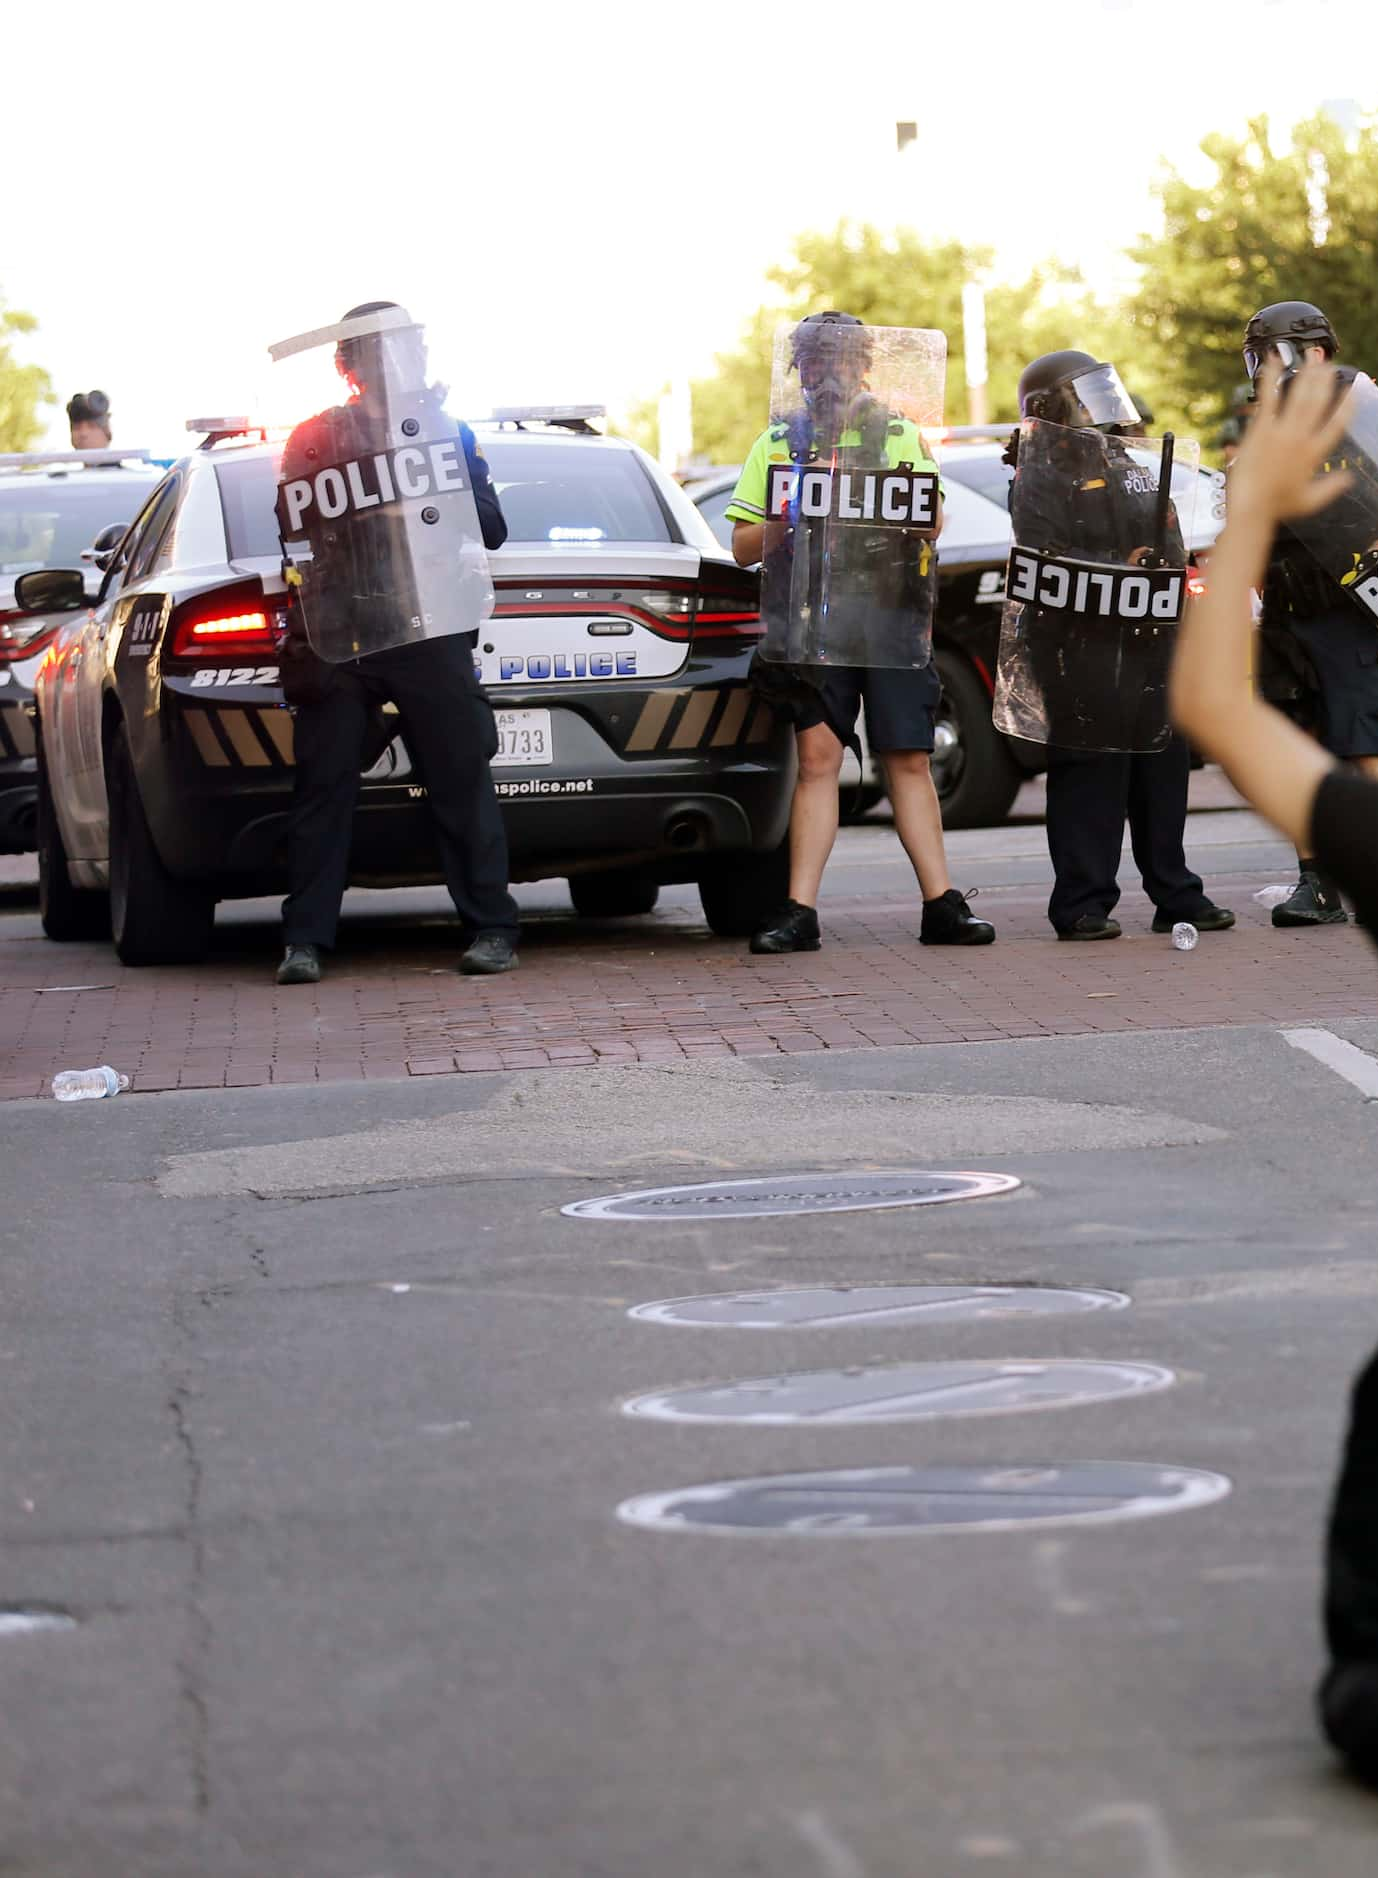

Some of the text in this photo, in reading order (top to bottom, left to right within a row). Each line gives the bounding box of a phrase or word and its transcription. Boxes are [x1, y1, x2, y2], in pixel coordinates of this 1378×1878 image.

[284, 442, 463, 531] POLICE
[771, 470, 933, 521] POLICE
[1012, 555, 1180, 618] POLICE
[190, 667, 280, 688] 8122
[500, 651, 638, 680] POLICE
[497, 729, 544, 755] 733
